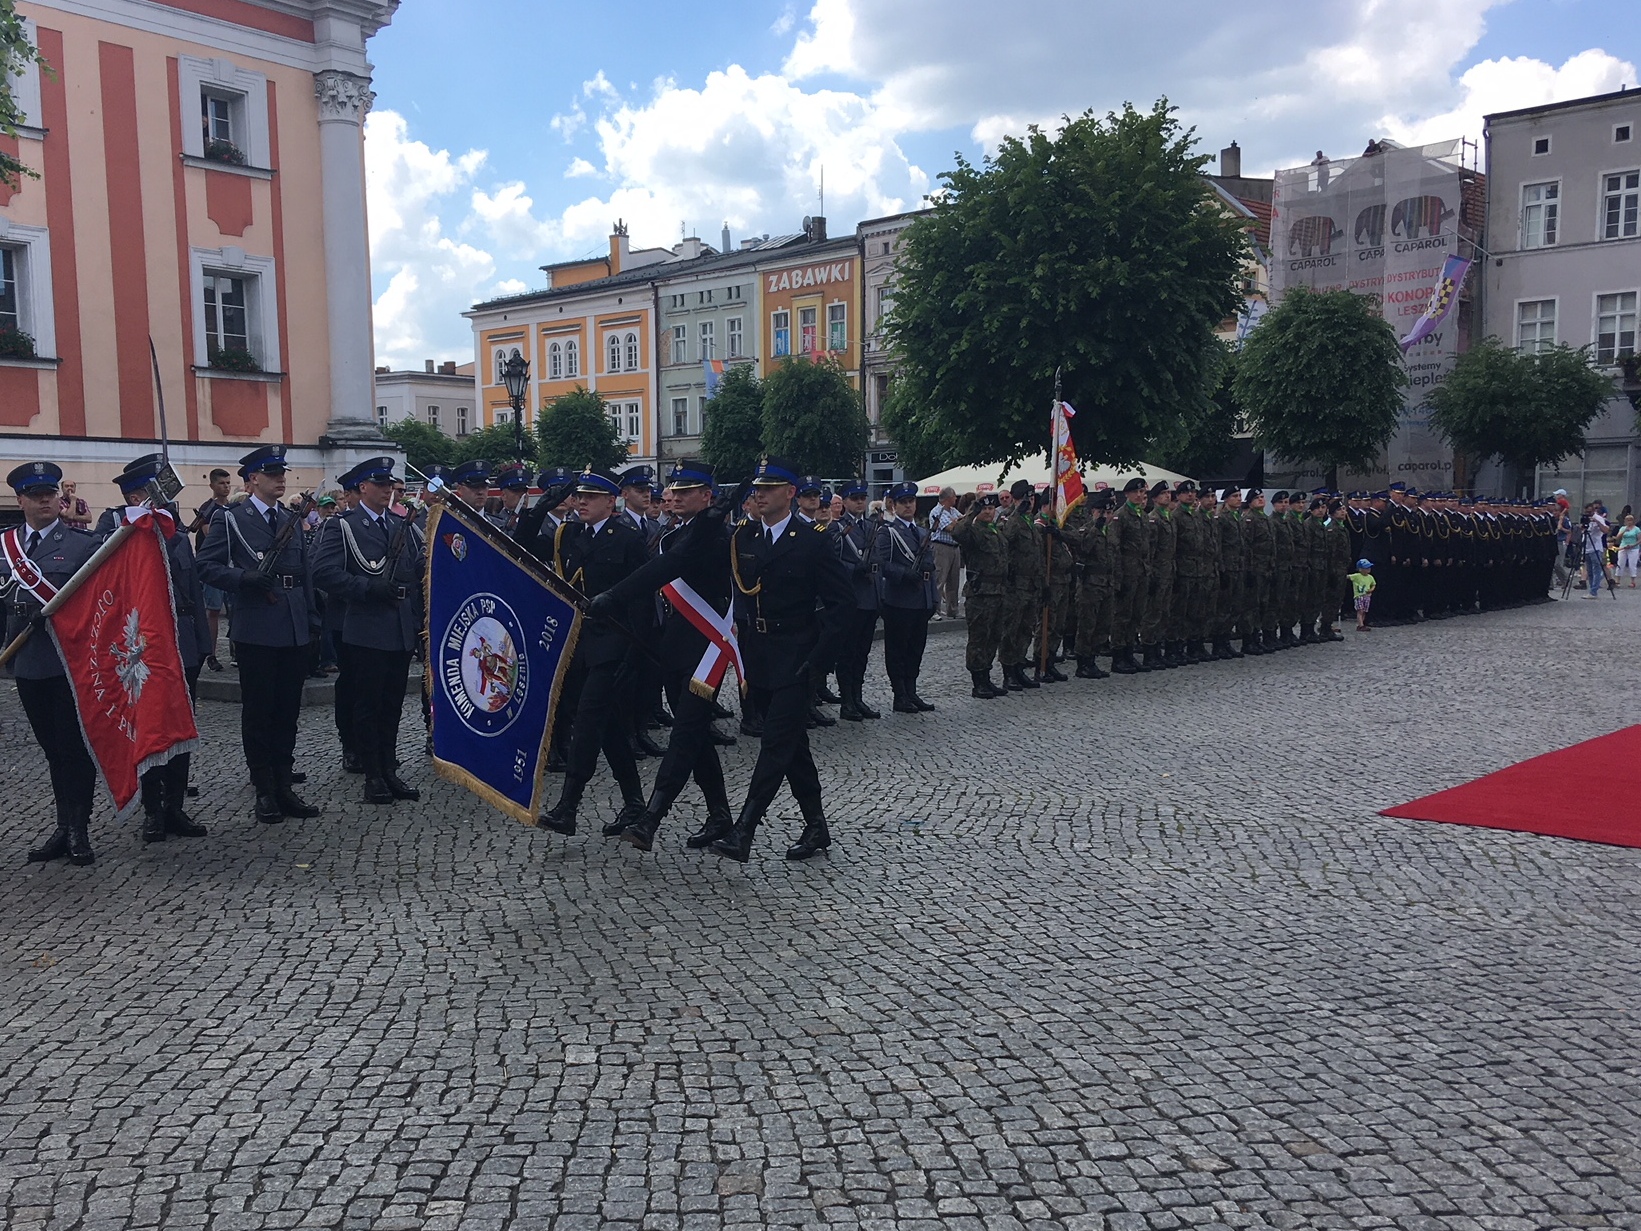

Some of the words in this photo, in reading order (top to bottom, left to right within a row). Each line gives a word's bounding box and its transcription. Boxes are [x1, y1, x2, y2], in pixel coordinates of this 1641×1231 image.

[1394, 238, 1447, 253] CAPAROL
[1290, 257, 1336, 271] CAPAROL
[1387, 266, 1442, 283] DYSTRYBUT
[768, 261, 850, 293] ZABAWKI
[1403, 363, 1442, 374] Systemy
[480, 599, 496, 614] PSP
[447, 602, 479, 651] MIEJSKA
[538, 615, 559, 651] 2018
[446, 658, 475, 719] KOMENDA
[513, 748, 527, 783] 1951
